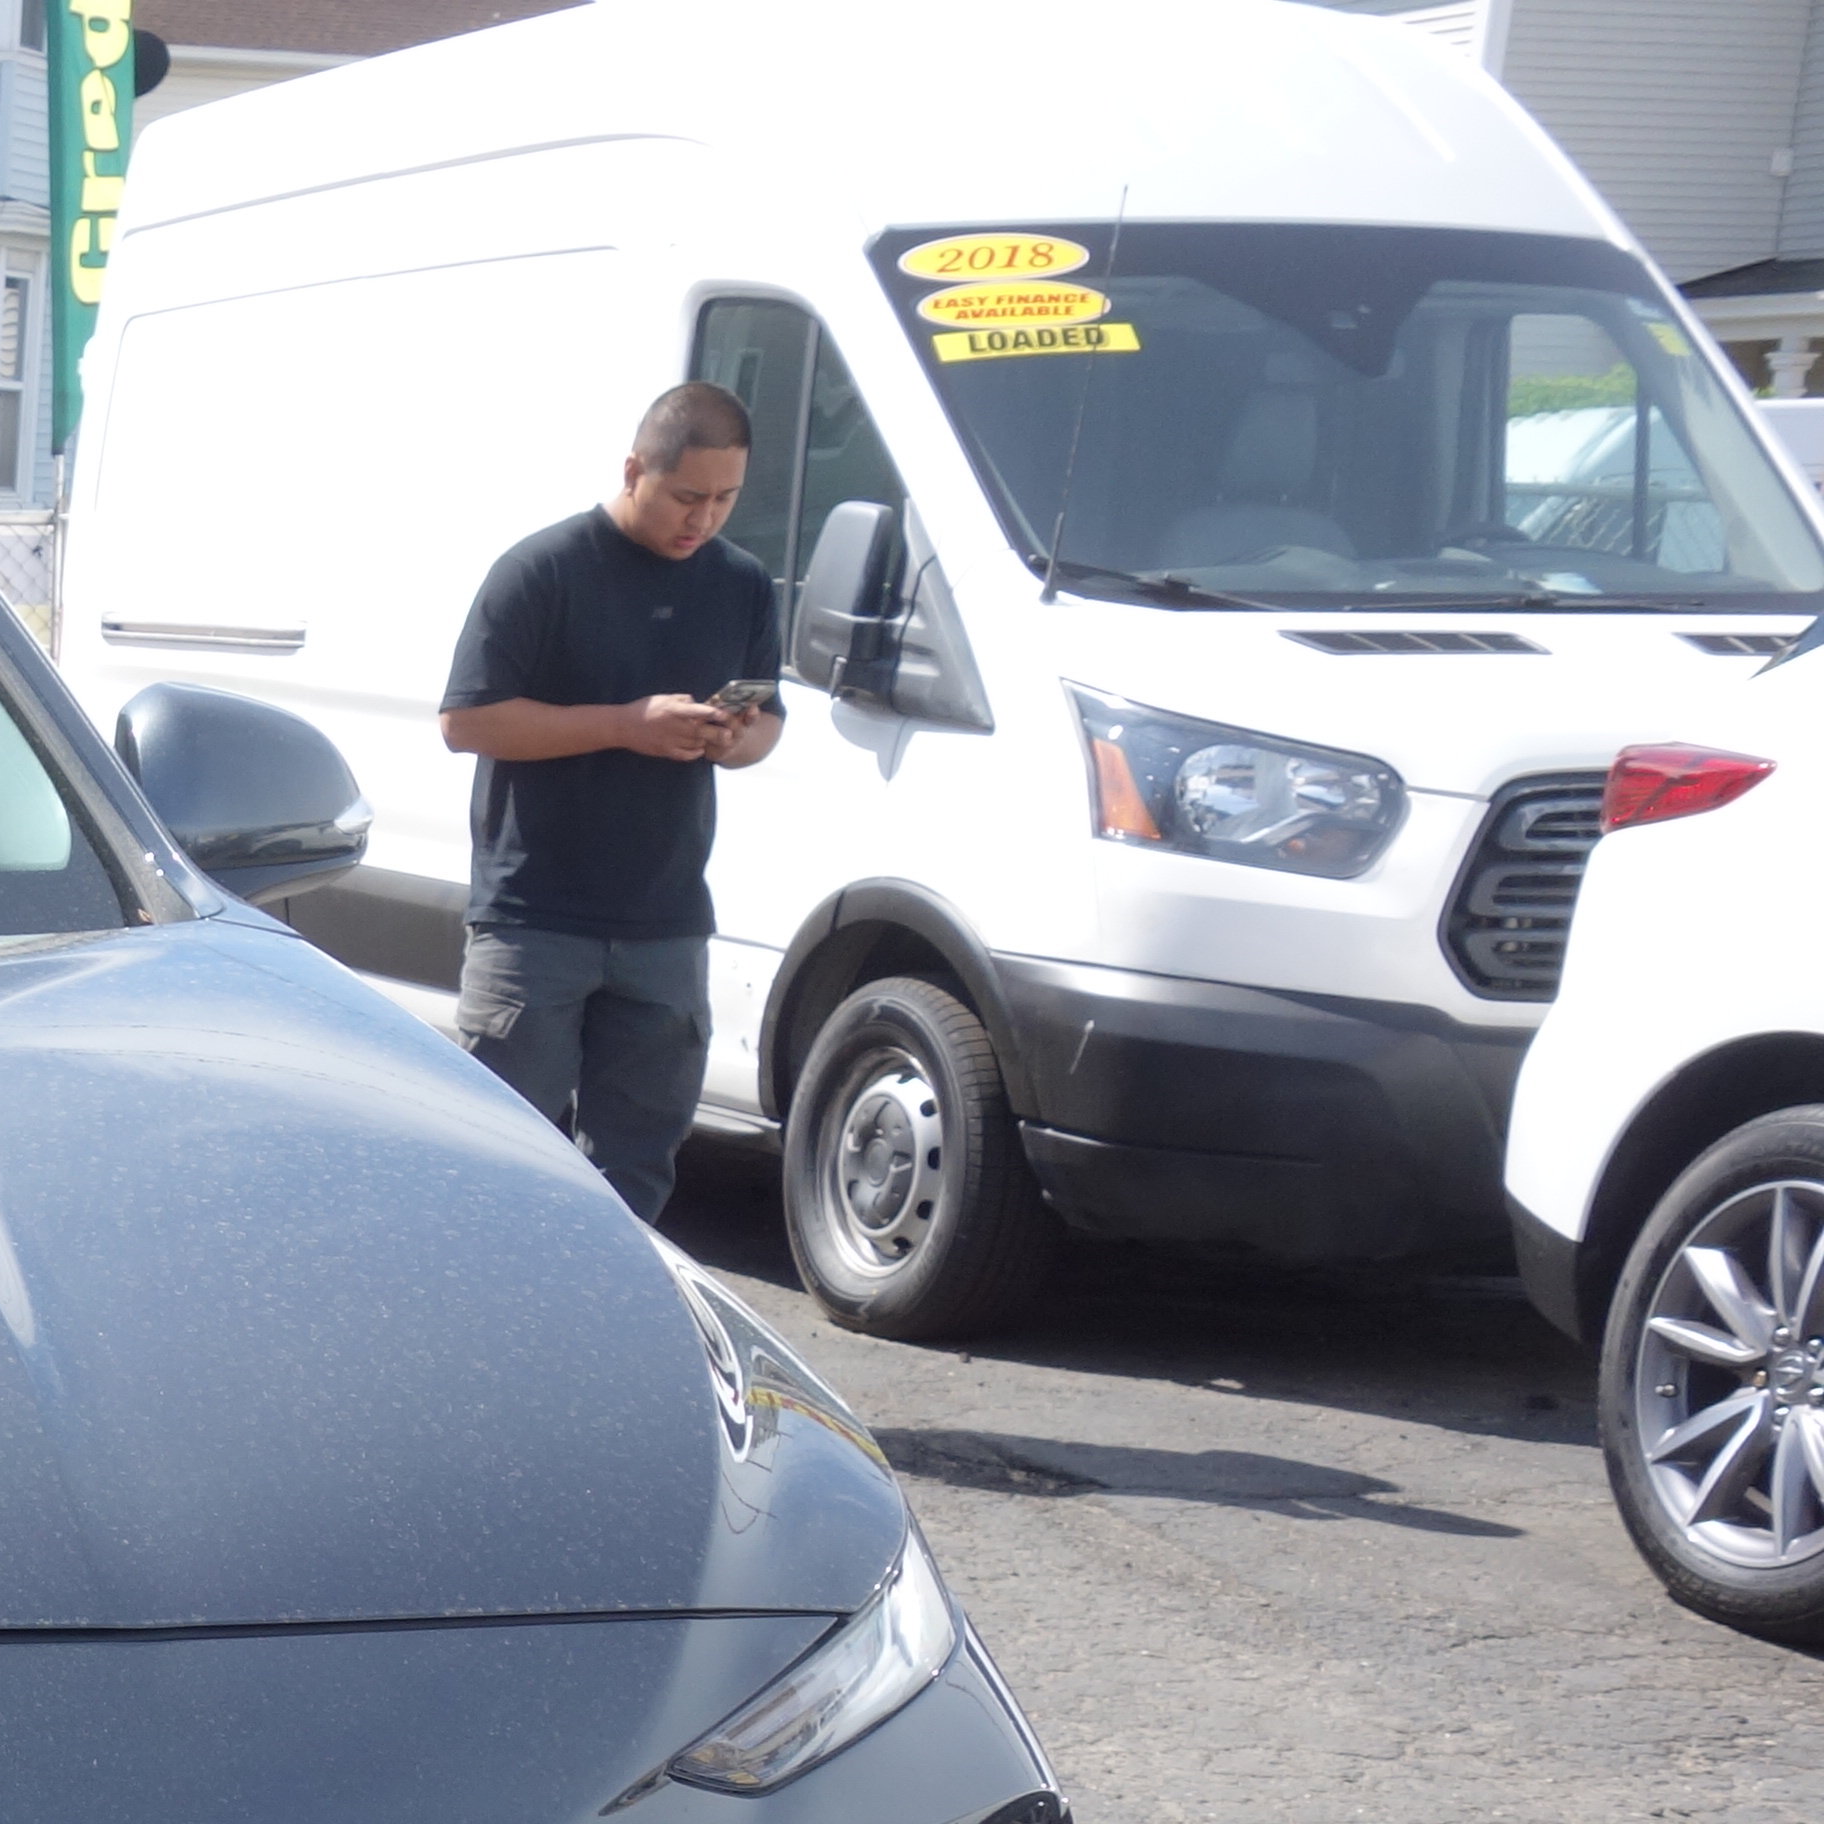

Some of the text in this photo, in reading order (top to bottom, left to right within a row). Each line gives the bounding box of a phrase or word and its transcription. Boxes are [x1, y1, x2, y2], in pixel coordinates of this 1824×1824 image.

[936, 242, 1055, 273] 2018
[933, 292, 1091, 309] EASY FINANCE
[955, 306, 1075, 320] AVAILABLE
[968, 326, 1106, 354] LOADED
